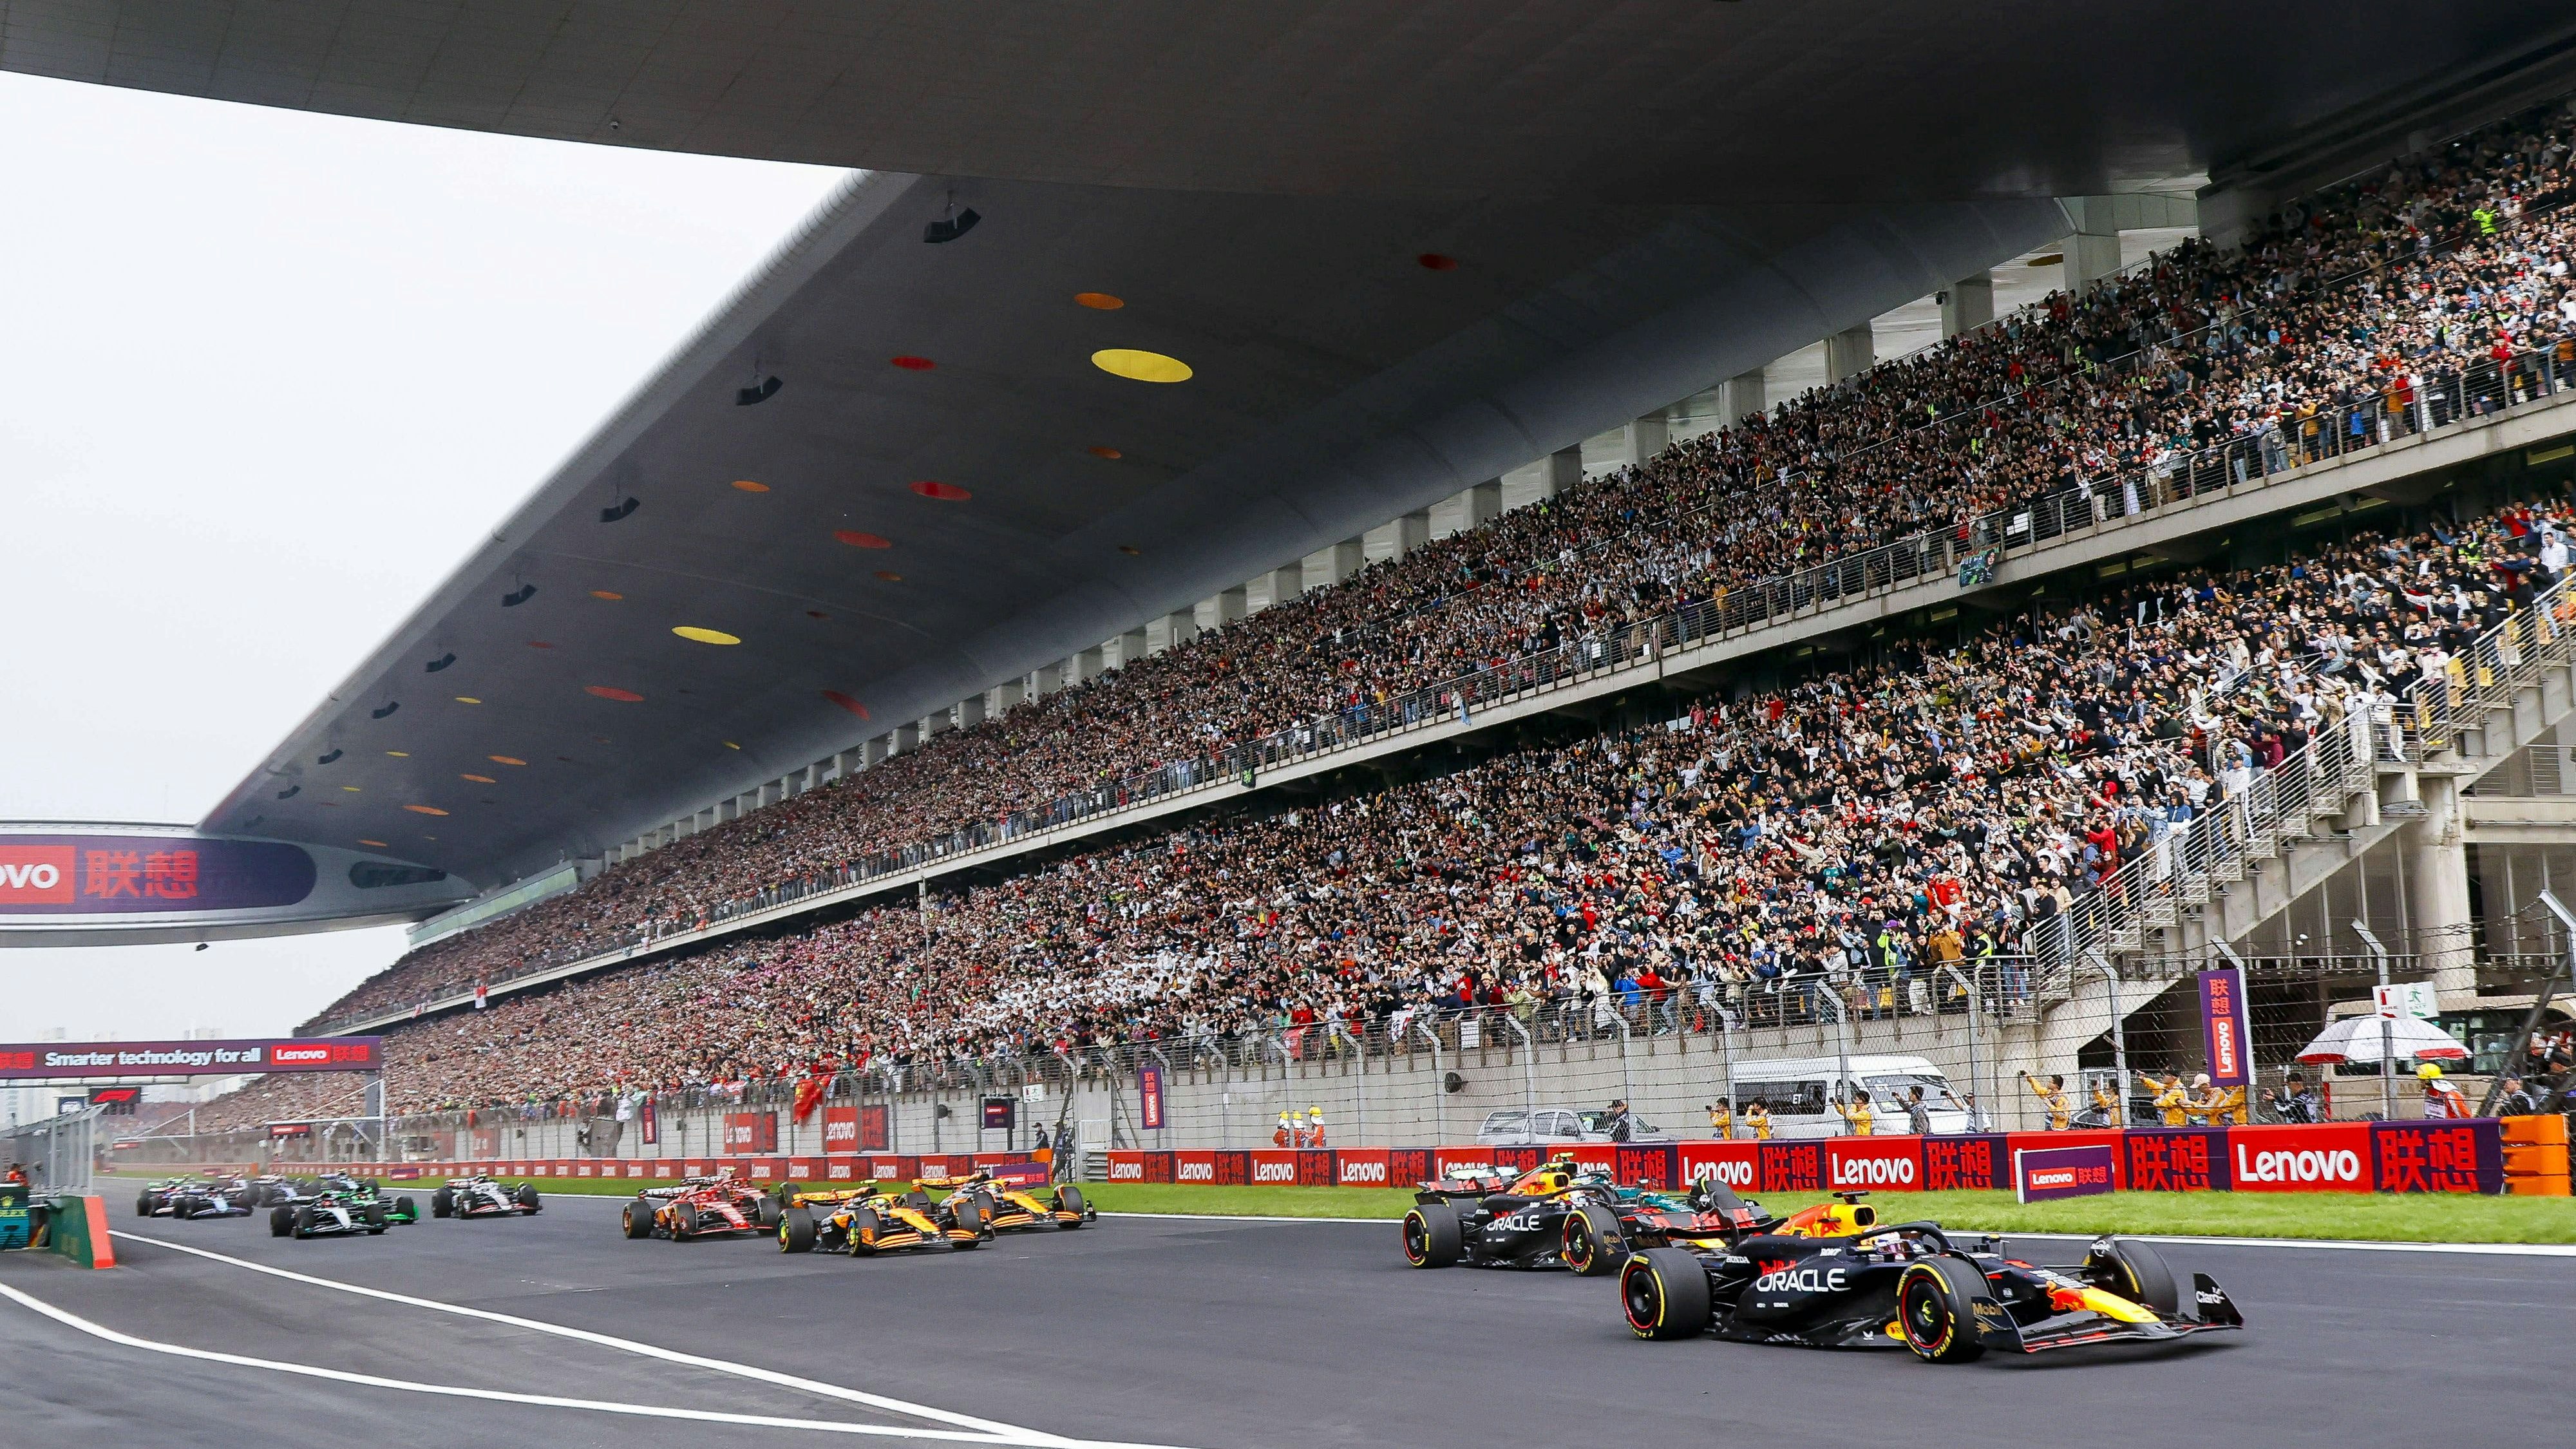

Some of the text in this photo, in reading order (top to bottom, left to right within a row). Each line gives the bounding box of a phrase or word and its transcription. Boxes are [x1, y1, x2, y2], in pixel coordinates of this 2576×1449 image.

[0, 864, 60, 889] vo
[84, 850, 199, 900] 联想
[2209, 978, 2231, 1015] 联想
[44, 1047, 261, 1066] Smarter technology for all
[276, 1048, 327, 1061] Lenovo
[2218, 1021, 2234, 1073] Lenovo
[1792, 1094, 1803, 1104] ET
[829, 1162, 851, 1179] Lenovo
[873, 1162, 897, 1179] Lenovo
[921, 1161, 946, 1179] Lenovo
[1110, 1159, 1141, 1179] Lenovo
[1178, 1159, 1212, 1180] Lenovo
[1254, 1159, 1294, 1181] Lenovo
[1341, 1158, 1385, 1182] Lenovo
[1683, 1157, 1752, 1186] Lenovo
[1763, 1146, 1818, 1192] 联想
[1832, 1152, 1915, 1185] Lenovo
[1927, 1141, 1992, 1191] 联想
[2128, 1135, 2211, 1191] 联想
[2237, 1143, 2361, 1182] Lenovo
[2377, 1128, 2478, 1194] 联想
[2032, 1170, 2074, 1185] Lenovo
[2078, 1167, 2108, 1184] 联想
[1486, 1215, 1544, 1231] ORACLE
[1756, 1268, 1851, 1292] ORACLE
[1972, 1302, 2002, 1316] Mobil
[2195, 1290, 2222, 1305] Claro
[1933, 1325, 1954, 1357] ZERO
